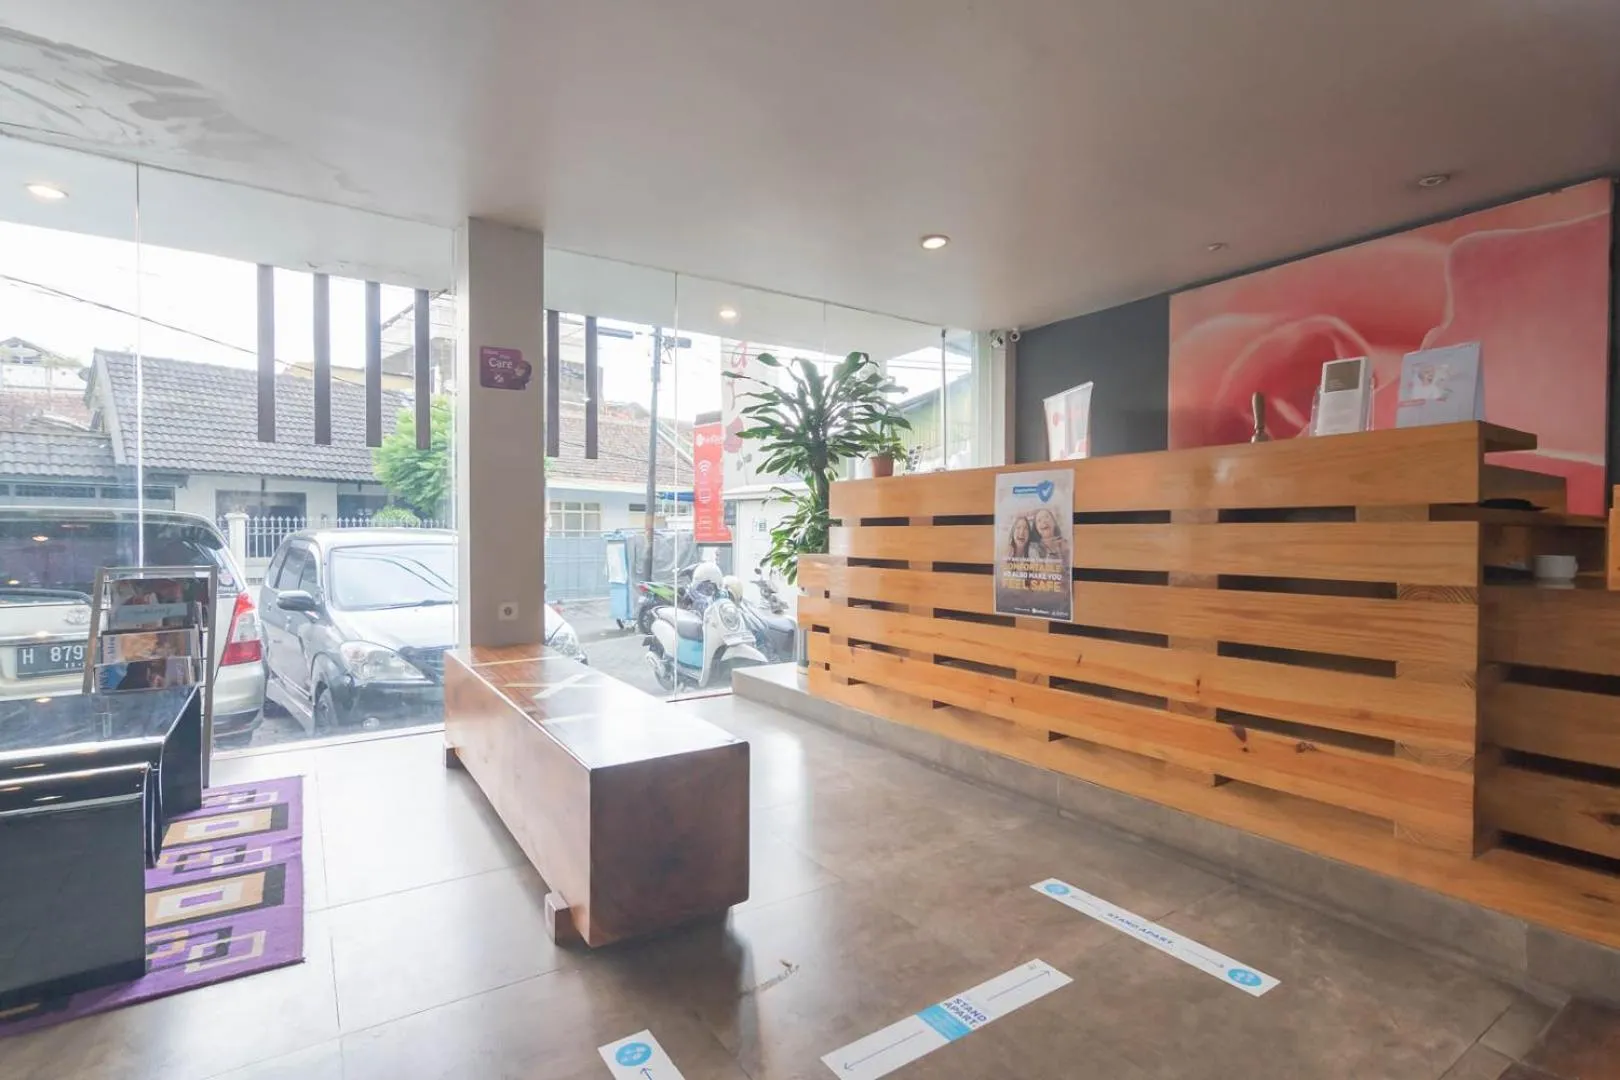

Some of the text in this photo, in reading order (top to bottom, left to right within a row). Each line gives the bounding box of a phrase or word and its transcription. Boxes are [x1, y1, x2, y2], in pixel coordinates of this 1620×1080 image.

[488, 357, 513, 369] Care
[1030, 579, 1061, 592] SAFE
[22, 648, 34, 665] H
[1107, 912, 1138, 929] STAND
[953, 998, 987, 1021] STAND
